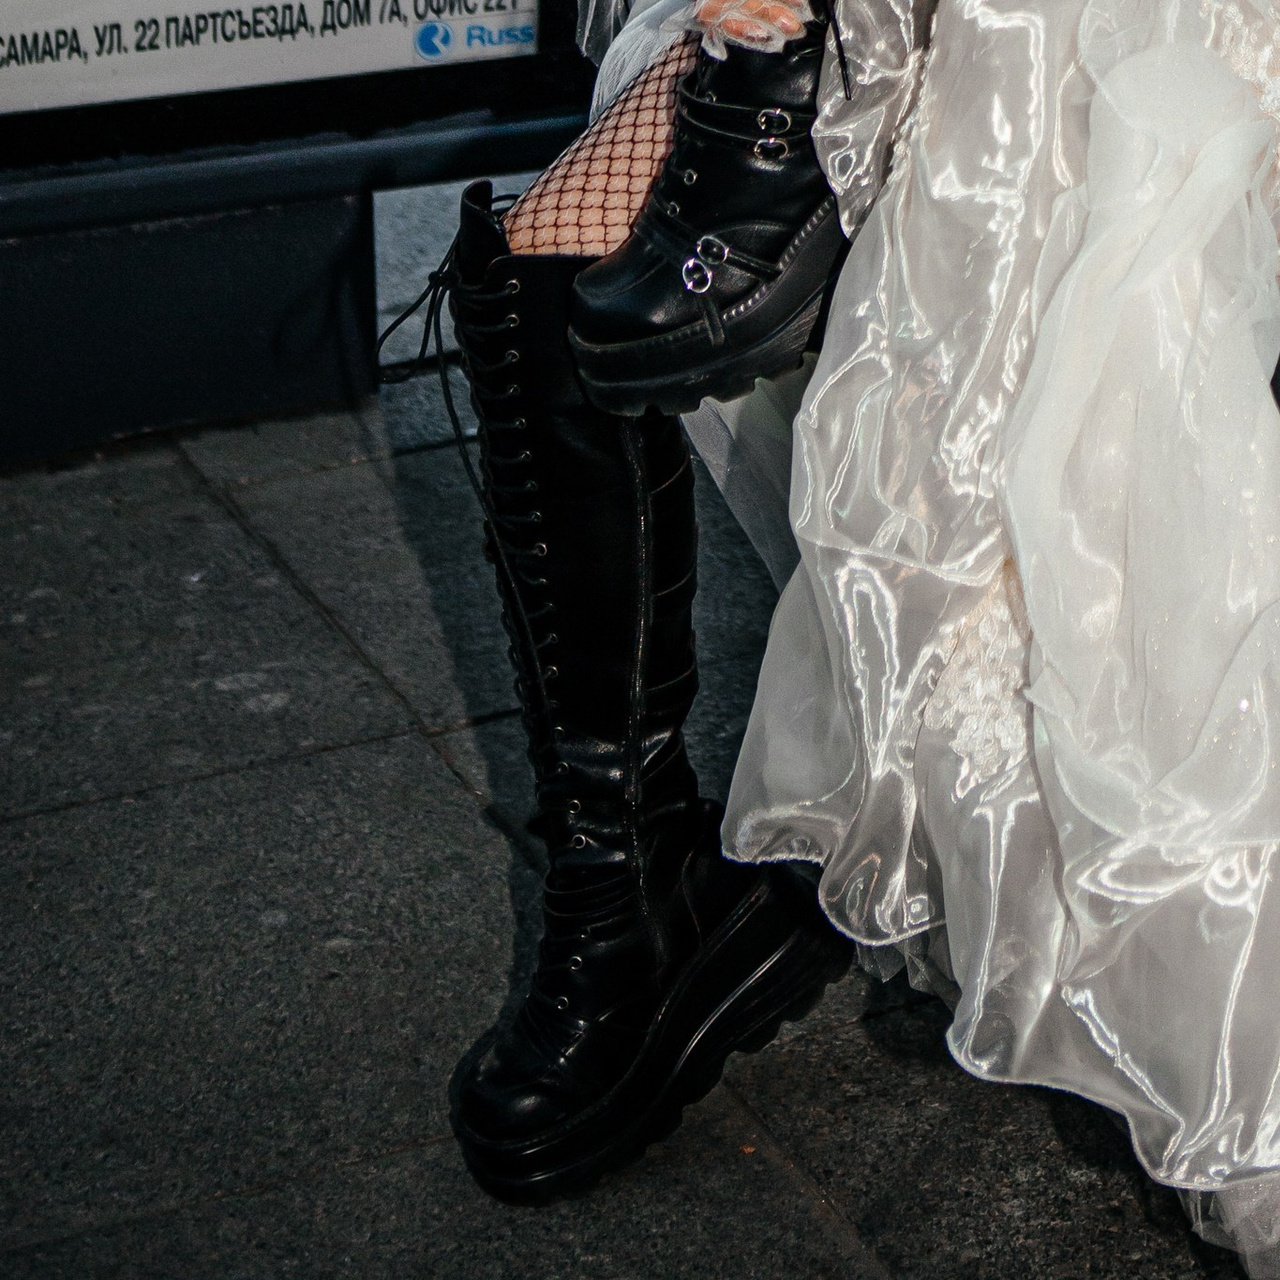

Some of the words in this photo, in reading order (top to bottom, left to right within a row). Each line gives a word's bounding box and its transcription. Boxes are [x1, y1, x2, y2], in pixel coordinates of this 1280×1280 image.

[93, 22, 128, 56] УЛ.
[134, 18, 160, 52] 22
[165, 2, 315, 49] ПАРТСЪЕЗДА,
